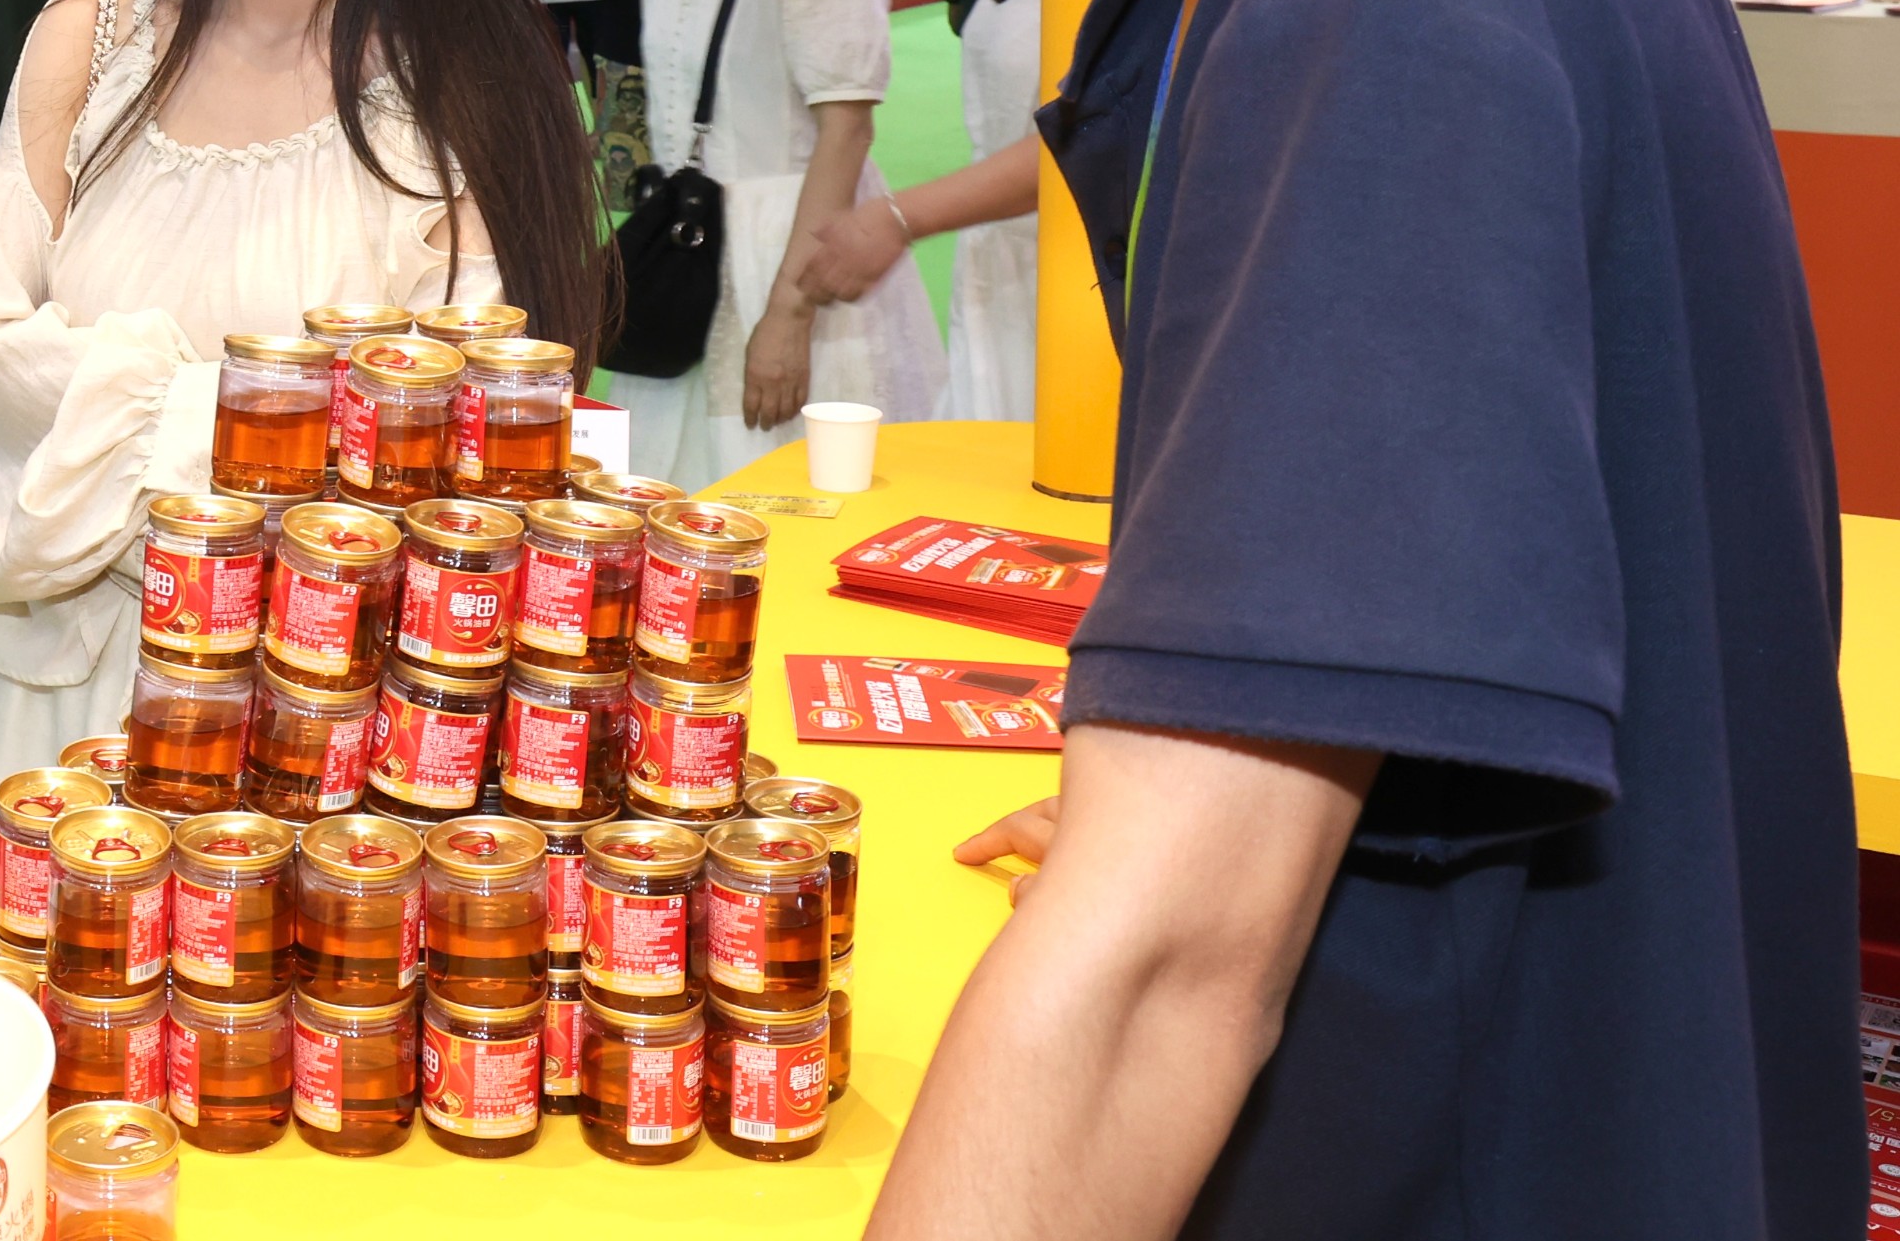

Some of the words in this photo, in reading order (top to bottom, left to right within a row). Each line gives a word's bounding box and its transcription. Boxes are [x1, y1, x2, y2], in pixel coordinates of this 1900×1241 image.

[470, 387, 482, 399] F9
[363, 398, 376, 411] F9
[576, 560, 592, 572] F9
[681, 568, 697, 581] F9
[342, 585, 358, 596] F9
[449, 592, 498, 618] 馨田
[865, 680, 904, 734] 吃麻辣火锅
[476, 716, 488, 727] F9
[571, 713, 586, 725] F9
[727, 713, 739, 725] F9
[216, 892, 231, 903] F9
[668, 897, 683, 909] F9
[745, 896, 760, 908] F9
[184, 1031, 197, 1044] F9
[323, 1036, 339, 1048] F9
[527, 1037, 538, 1050] F9
[789, 1057, 826, 1091] 馨田
